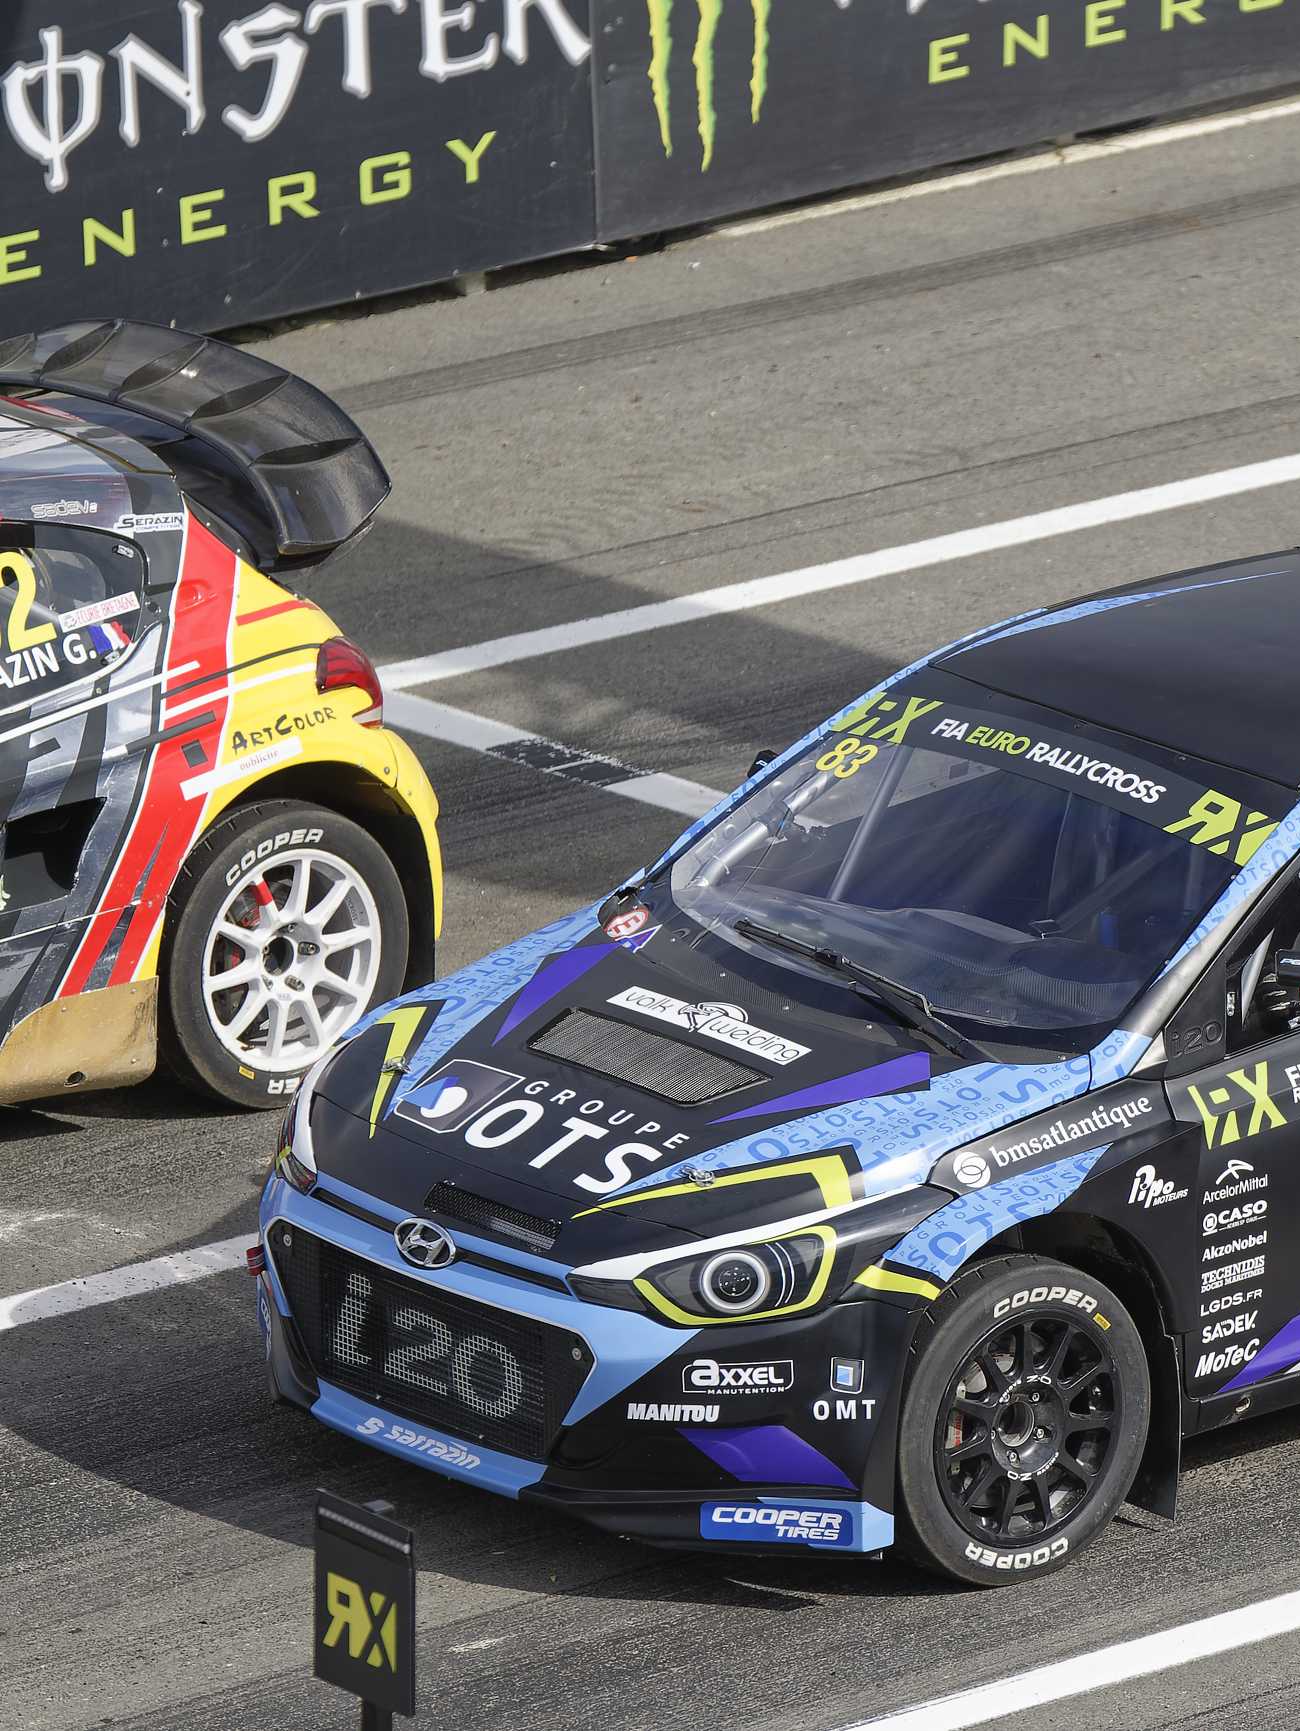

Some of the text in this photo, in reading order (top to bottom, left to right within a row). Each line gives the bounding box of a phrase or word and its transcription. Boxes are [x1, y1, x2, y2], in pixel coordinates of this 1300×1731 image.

[928, 0, 1284, 84] ENER
[0, 131, 497, 286] ENERGY
[117, 516, 183, 528] SERAZIN
[62, 633, 97, 665] G.
[815, 737, 878, 778] 83
[931, 718, 1167, 804] FIA EURO RALLYCROSS
[225, 828, 324, 887] COOPER
[625, 991, 801, 1063] valk welding
[525, 1080, 690, 1150] GROUPE
[464, 1099, 663, 1194] OTS
[989, 1096, 1153, 1168] bmsatlantique
[1152, 1189, 1189, 1206] MOTEURS
[1202, 1173, 1268, 1205] ArcelorMittal
[1218, 1200, 1268, 1225] CASO
[1201, 1230, 1268, 1262] AkzoNobel
[1201, 1255, 1265, 1286] TECHNIDIS
[1201, 1266, 1265, 1293] DOCKS MARITIMES
[993, 1286, 1098, 1319] COOPER
[1200, 1288, 1263, 1317] LGDS.FR
[1194, 1338, 1260, 1378] MoTeC
[707, 1387, 785, 1395] MANUTENTION
[627, 1403, 720, 1423] MANITOU
[384, 1425, 481, 1470] sarrazin
[711, 1506, 843, 1528] COOPER
[775, 1524, 841, 1541] TIRES
[965, 1537, 1070, 1570] COOPER
